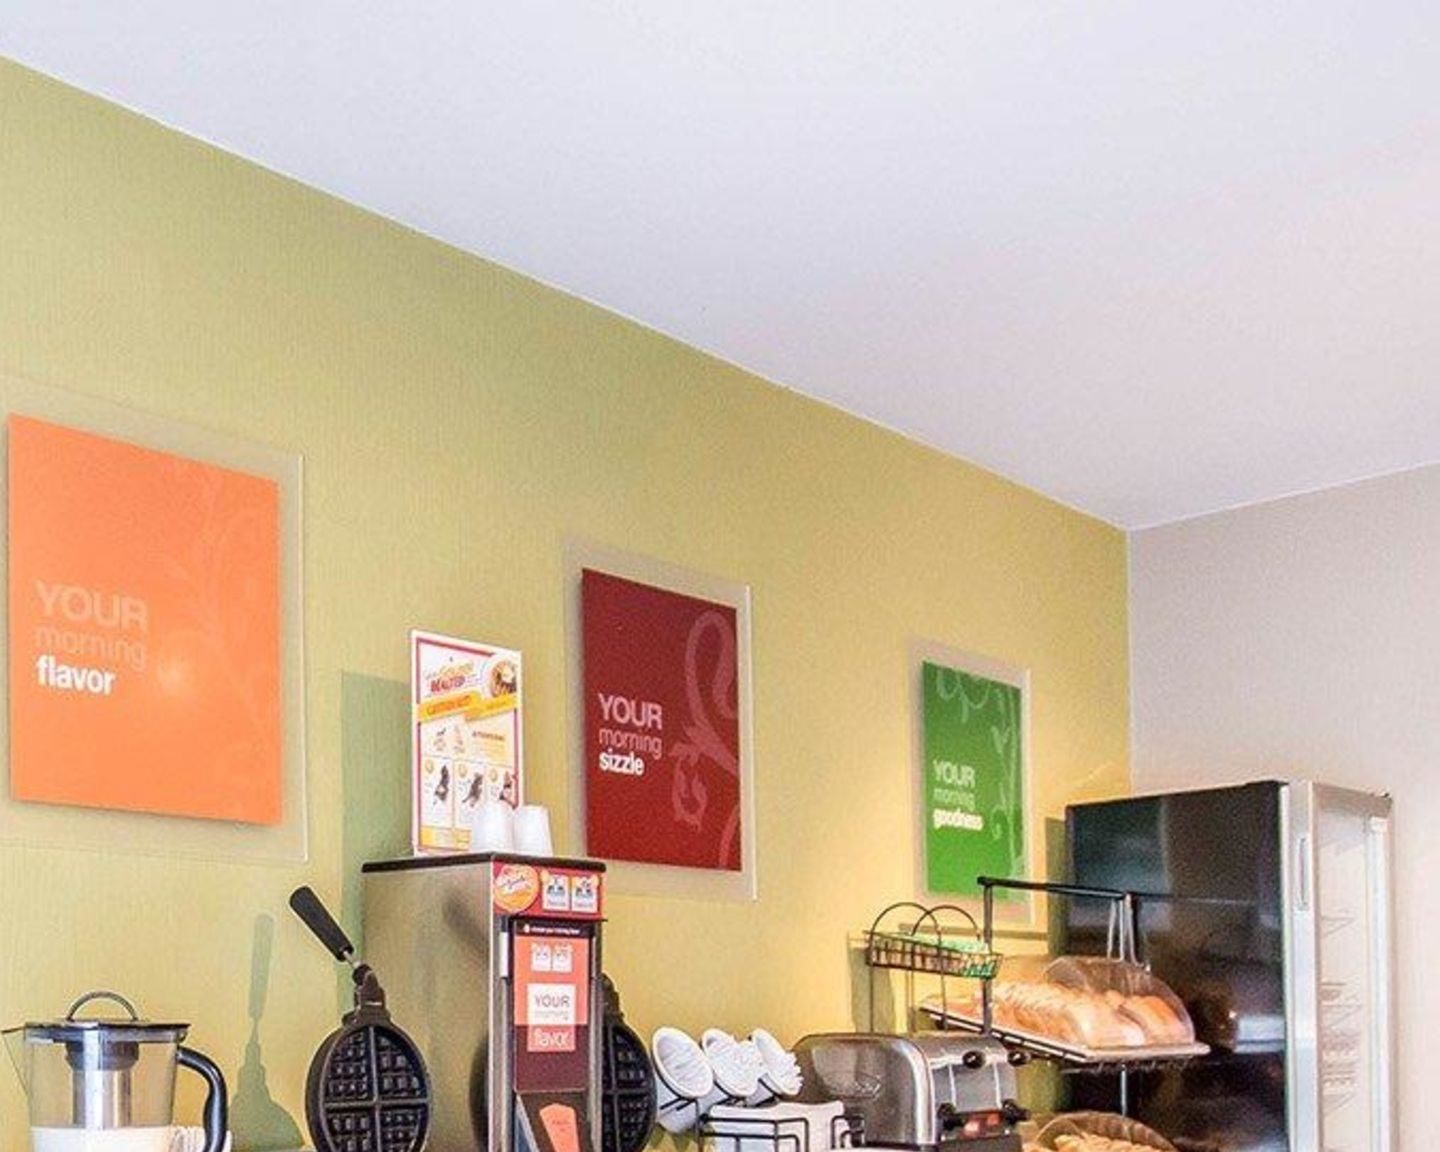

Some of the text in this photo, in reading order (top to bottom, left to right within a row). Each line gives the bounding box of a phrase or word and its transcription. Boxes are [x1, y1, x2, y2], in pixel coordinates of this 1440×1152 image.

[35, 580, 148, 632] YOUR
[36, 624, 146, 673] morning
[35, 654, 116, 695] flavor
[597, 692, 663, 731] YOUR
[598, 727, 662, 760] morning
[598, 748, 645, 776] sizzle
[932, 759, 976, 789] YOUR
[533, 993, 571, 1008] YOUR
